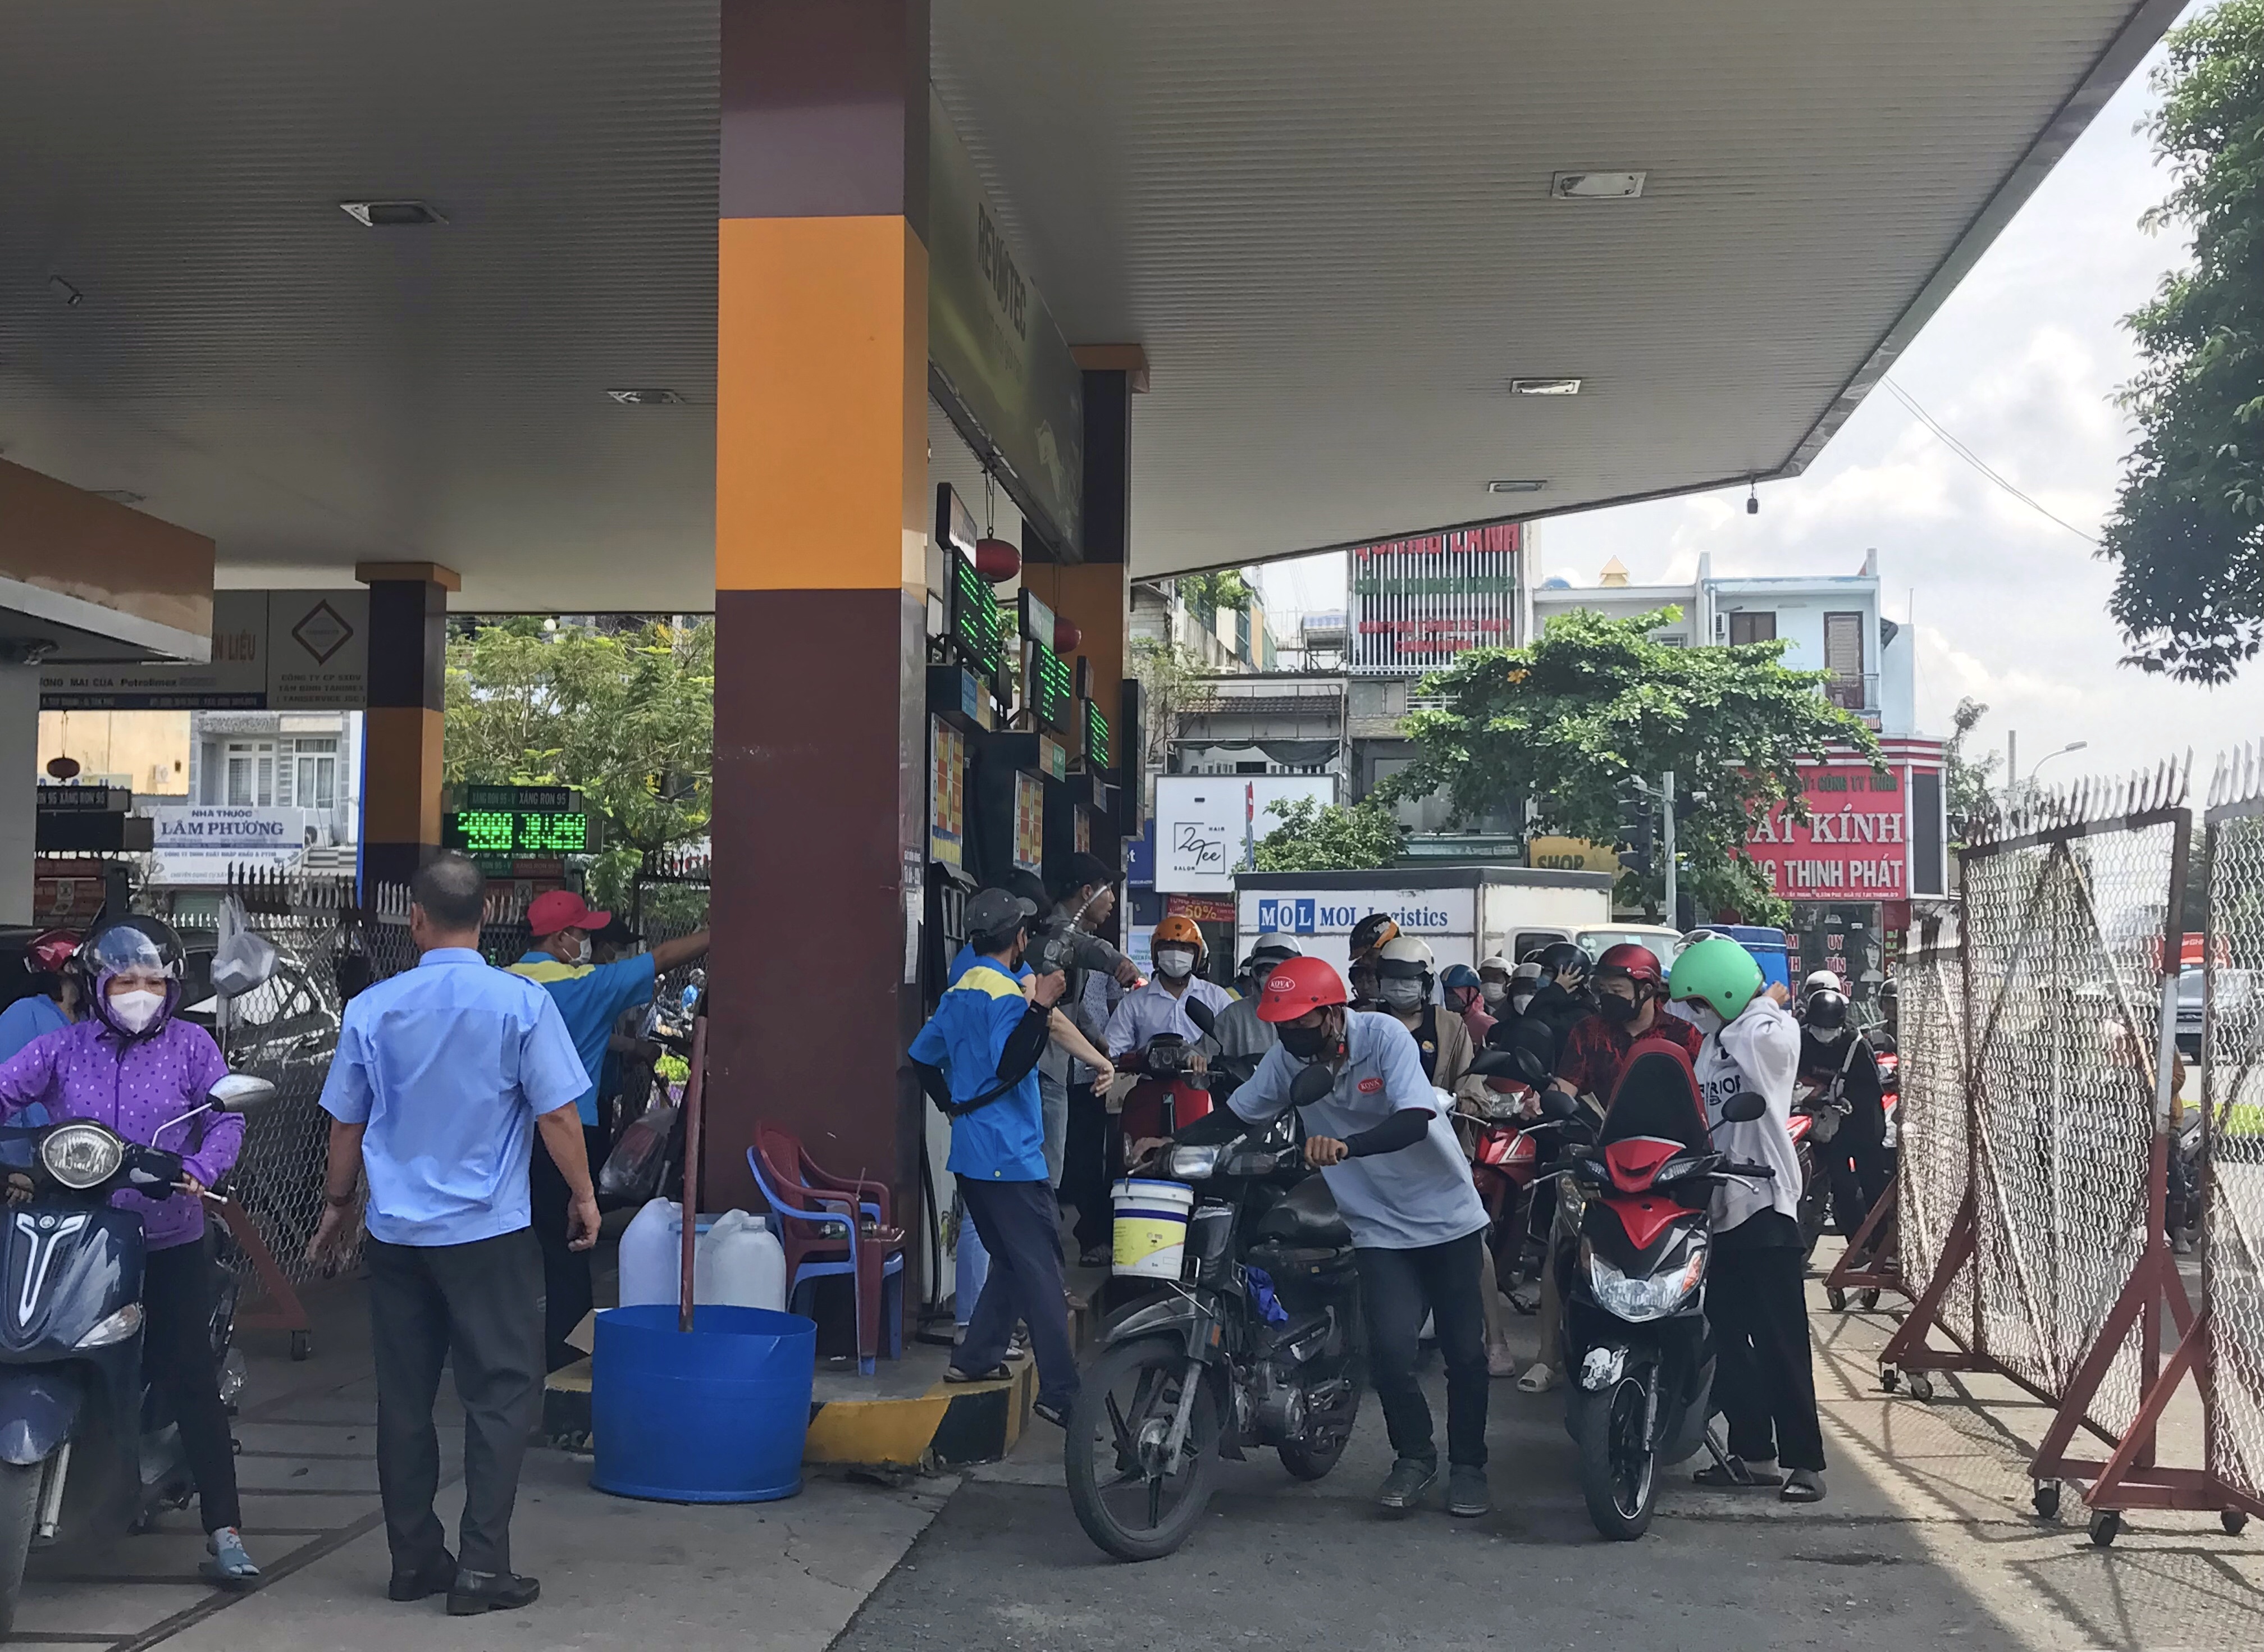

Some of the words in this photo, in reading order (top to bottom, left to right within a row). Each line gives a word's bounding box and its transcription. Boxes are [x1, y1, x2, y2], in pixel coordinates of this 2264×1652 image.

[1851, 775, 1864, 791] TY
[500, 793, 507, 804] 95
[540, 792, 555, 805] RON
[556, 793, 566, 805] 95
[191, 809, 214, 818] NHÀ
[161, 819, 203, 836] LÂM
[208, 820, 284, 836] PHƯƠNG
[1811, 803, 1904, 843] KÍNH
[1537, 855, 1585, 870] SHOP
[1783, 860, 1843, 895] THỊNH
[1850, 853, 1904, 887] PHÁT
[1185, 905, 1217, 919] 50%
[1261, 906, 1311, 927] MOL
[1827, 933, 1845, 950] UY
[1825, 953, 1847, 973] TÍN
[1360, 1079, 1380, 1090] KOVA
